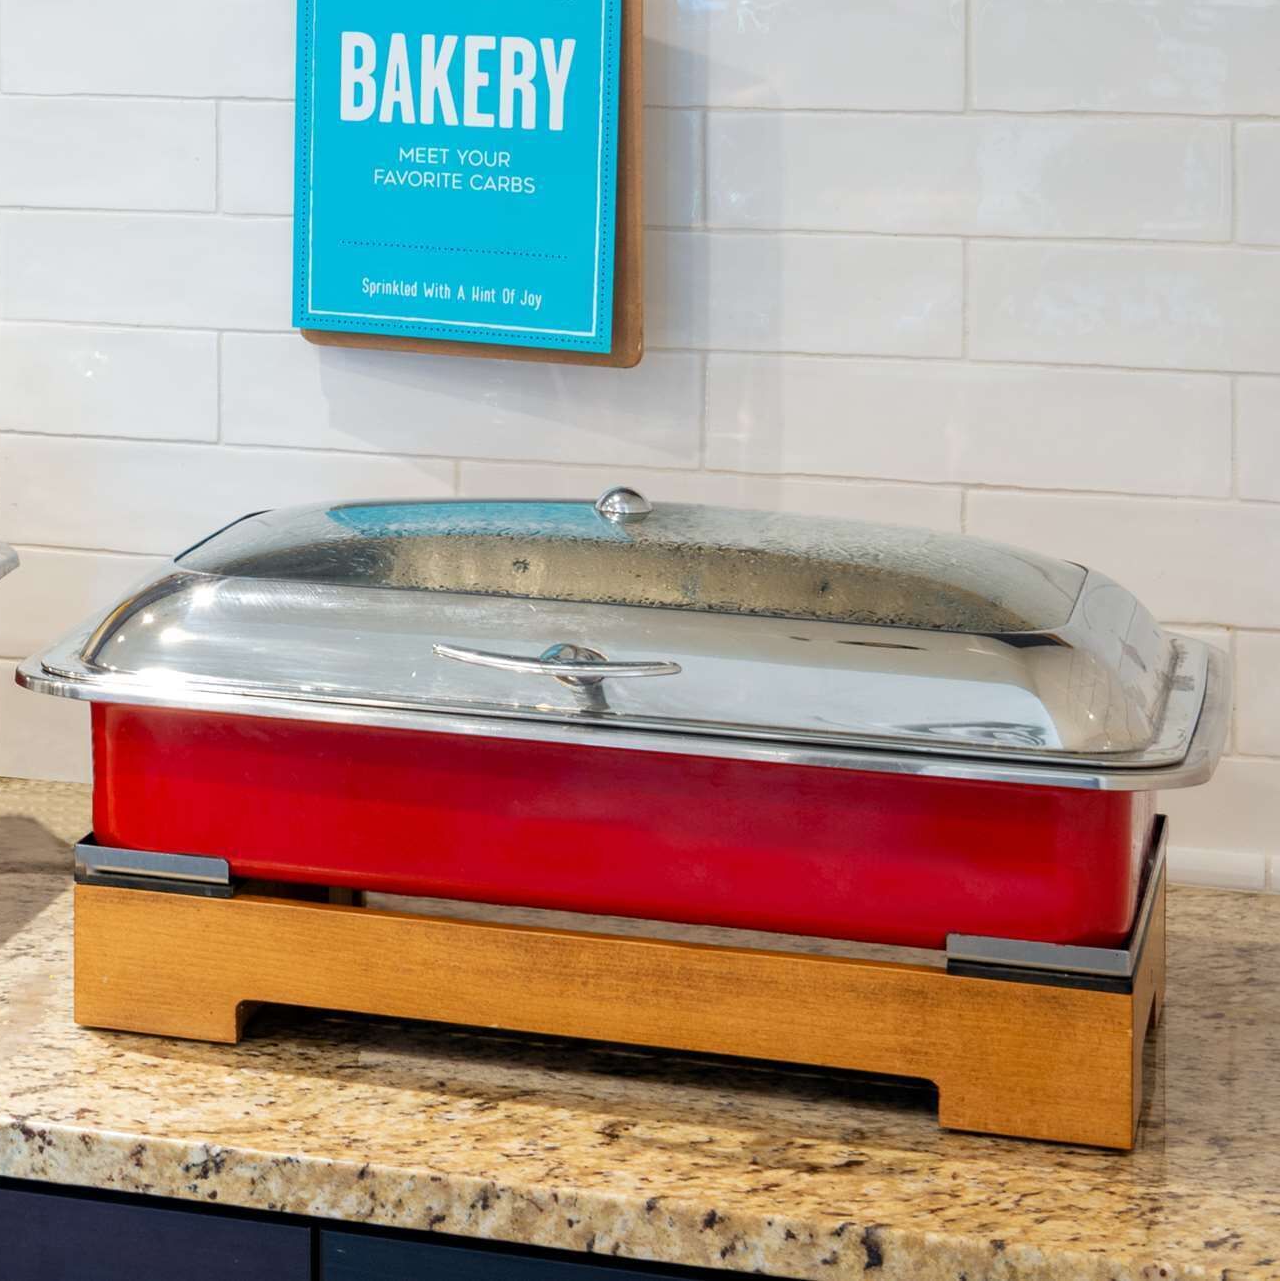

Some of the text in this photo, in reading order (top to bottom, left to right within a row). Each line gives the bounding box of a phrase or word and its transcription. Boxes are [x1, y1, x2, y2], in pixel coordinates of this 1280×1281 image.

[340, 30, 577, 131] BAKERY
[399, 147, 511, 167] MEET YOUR
[373, 168, 536, 194] FAVORITE CARBS
[361, 277, 542, 311] Sprinkled With A Hint Of Joy
